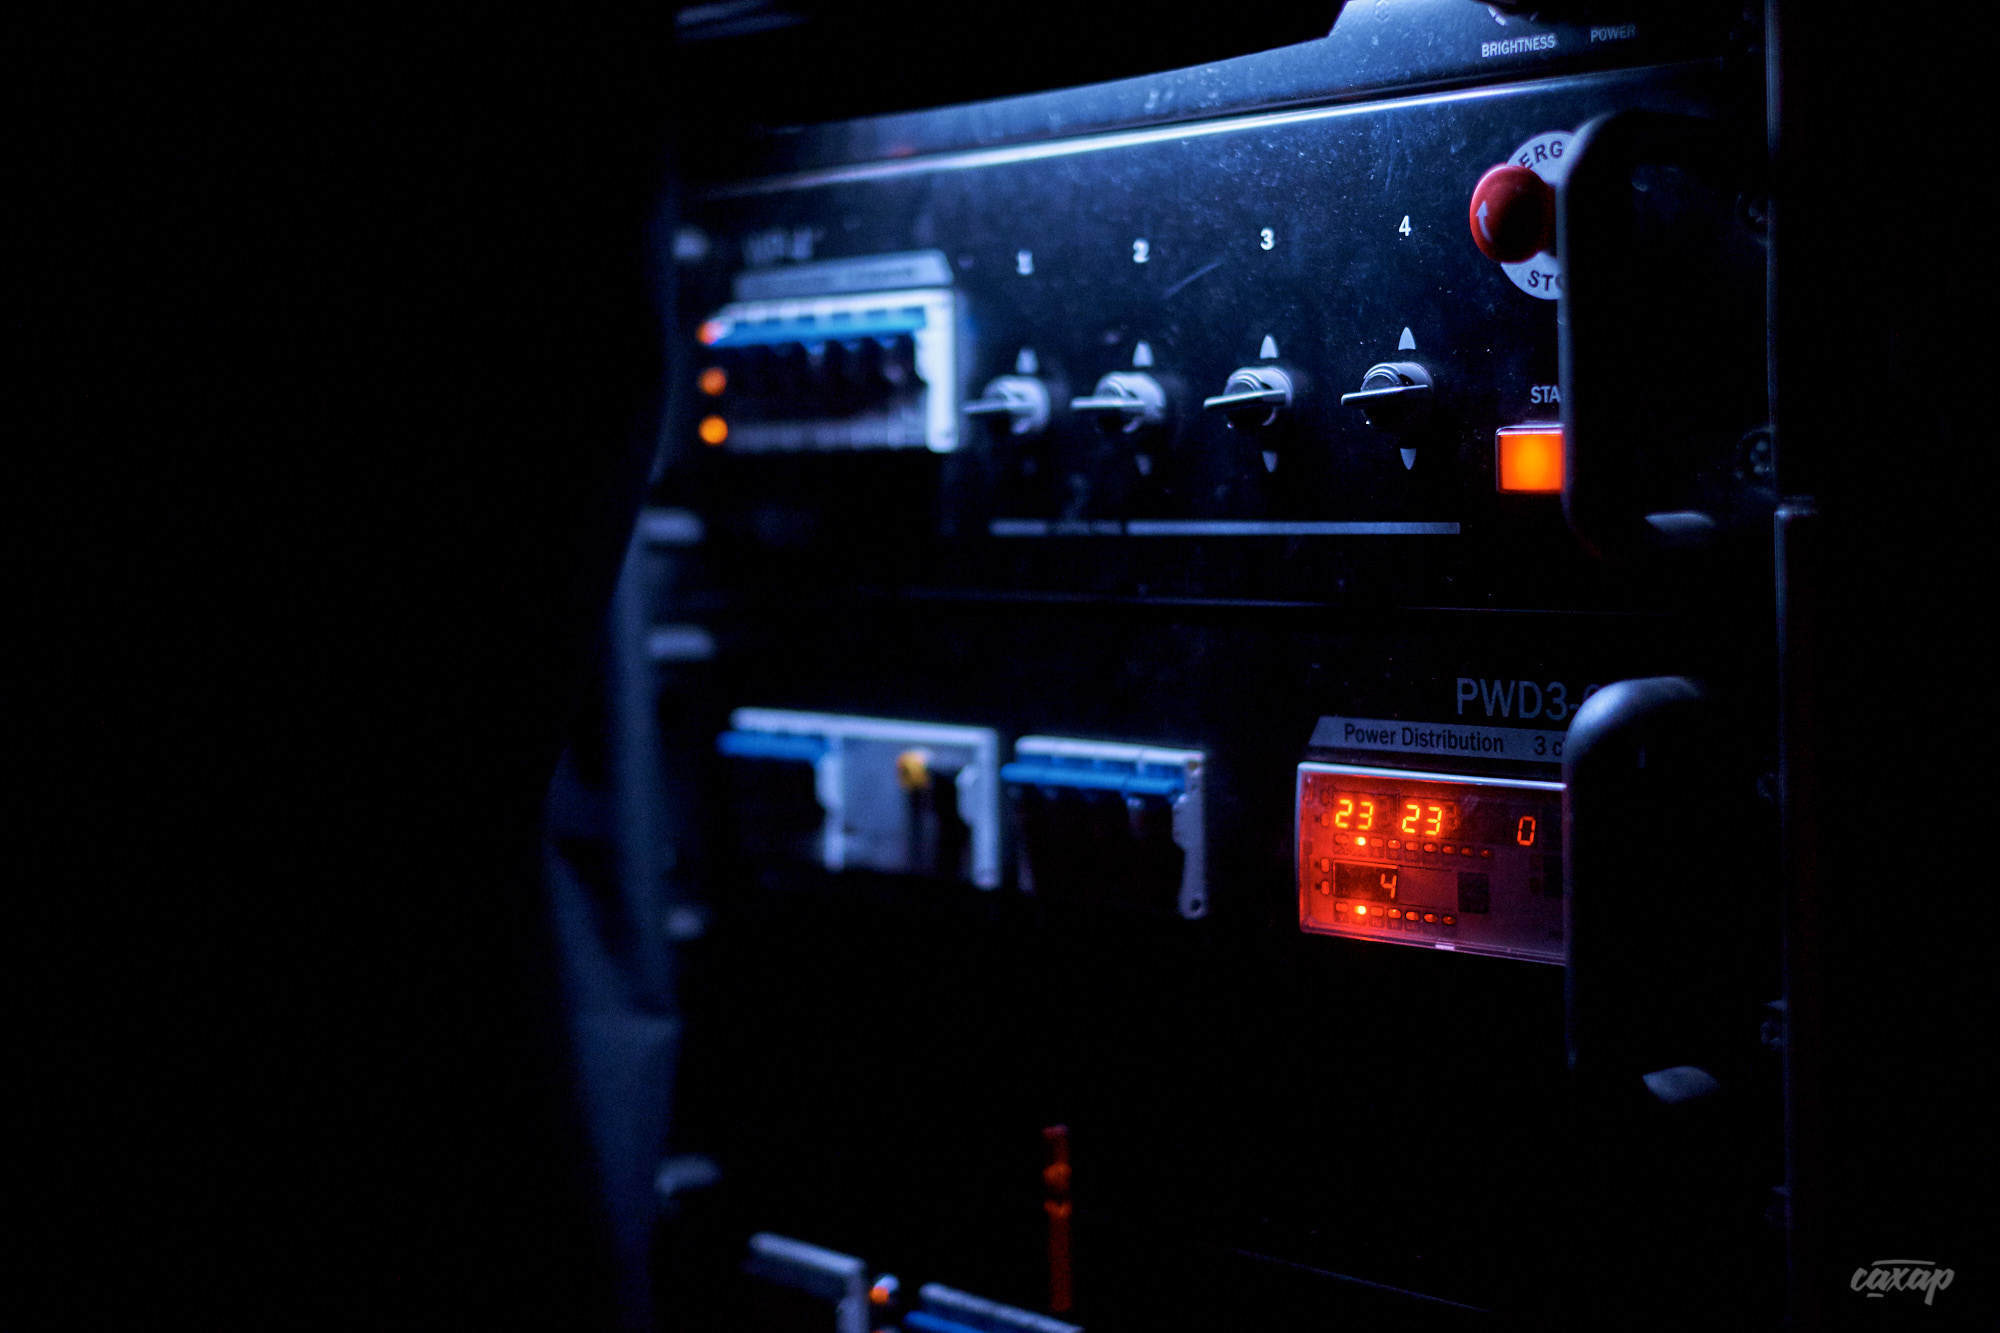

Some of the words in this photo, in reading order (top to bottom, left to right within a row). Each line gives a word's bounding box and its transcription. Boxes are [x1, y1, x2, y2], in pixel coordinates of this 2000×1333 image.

[1481, 33, 1557, 57] BRIGHTNESS
[1590, 24, 1638, 43] POWER
[1398, 214, 1413, 237] 4
[1132, 237, 1150, 264] 2
[1259, 226, 1275, 251] 3
[1344, 722, 1397, 745] Power
[1401, 726, 1504, 753] Distribution
[1534, 735, 1547, 756] 3
[1335, 799, 1374, 830] 23
[1401, 804, 1443, 836] 23
[1516, 815, 1537, 847] 0
[1379, 873, 1398, 899] 4
